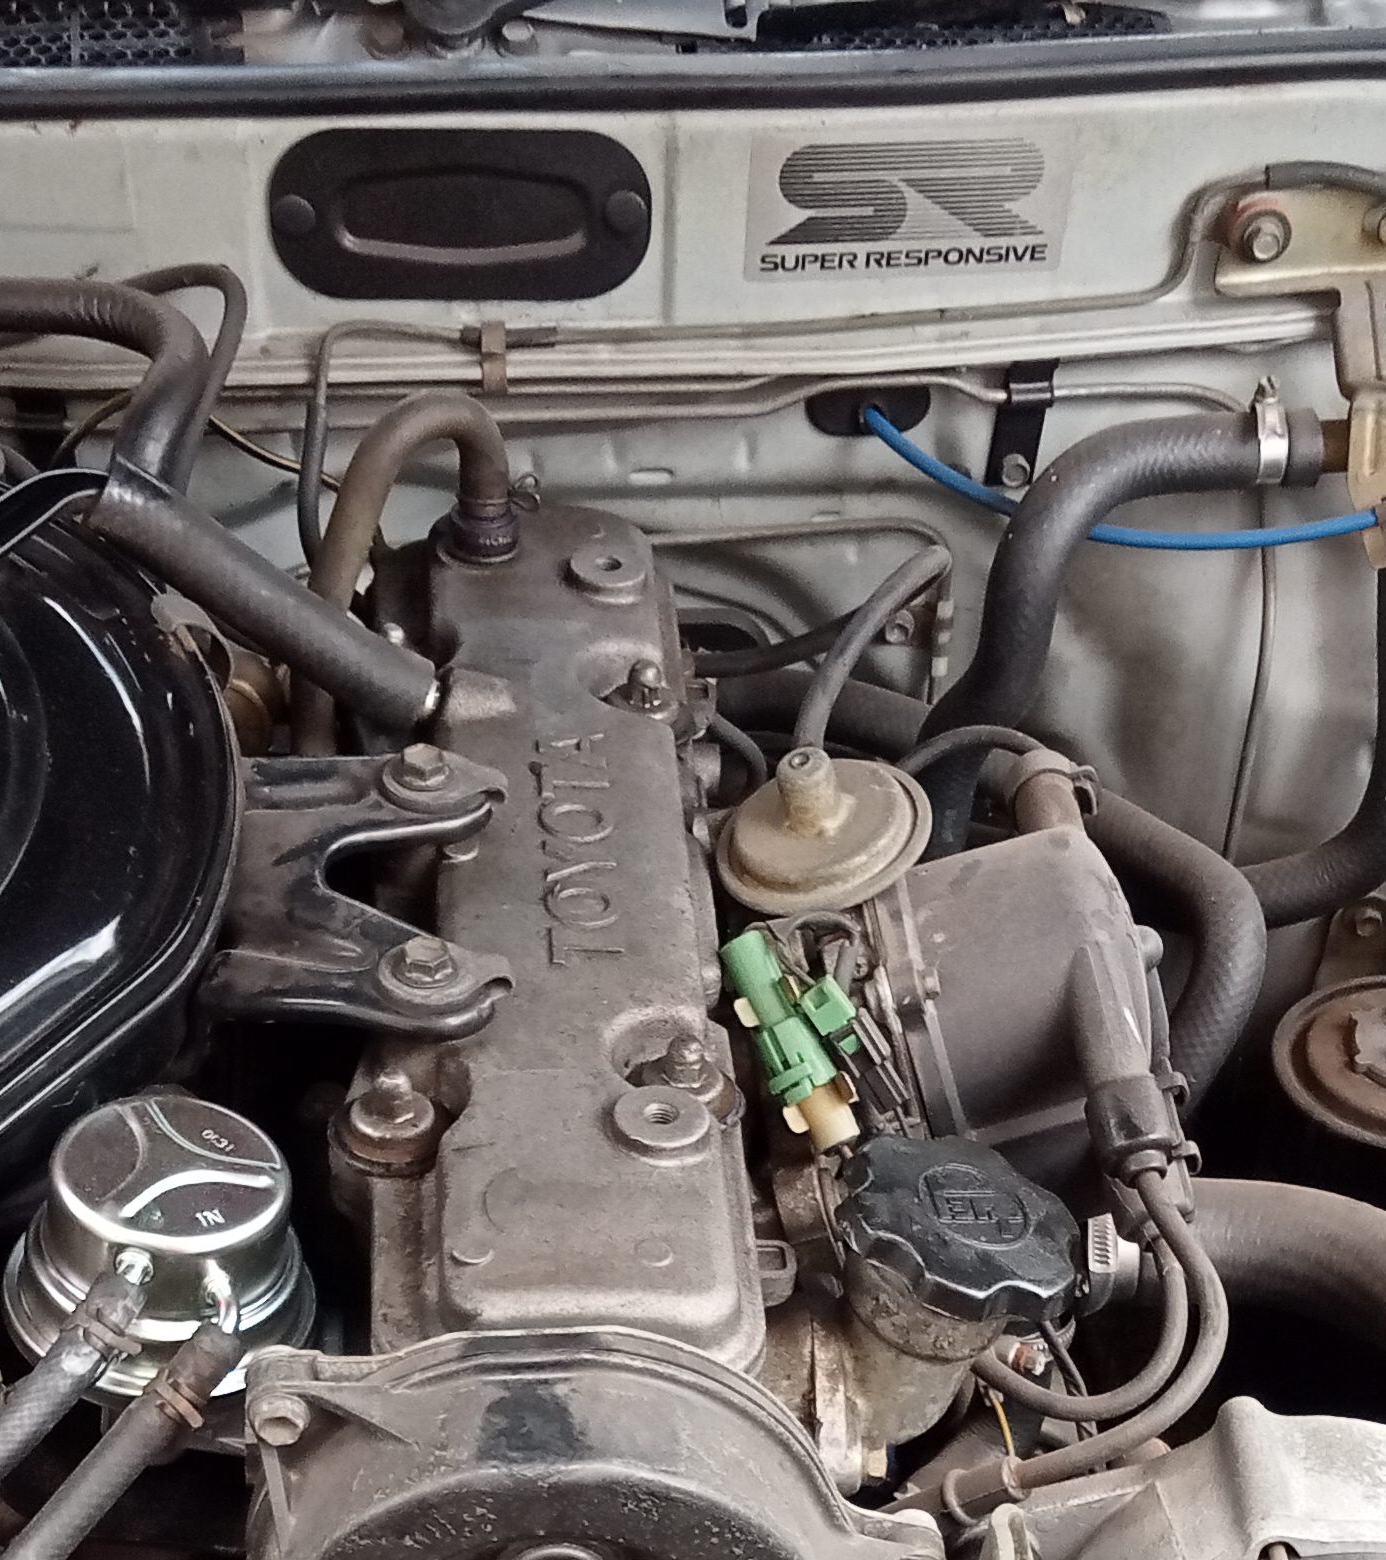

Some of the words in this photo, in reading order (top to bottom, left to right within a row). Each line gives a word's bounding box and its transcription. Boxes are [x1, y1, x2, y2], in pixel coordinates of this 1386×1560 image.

[760, 252, 858, 273] SUPER
[864, 243, 1048, 270] RESPONSIVE
[530, 732, 625, 968] TOYOTA
